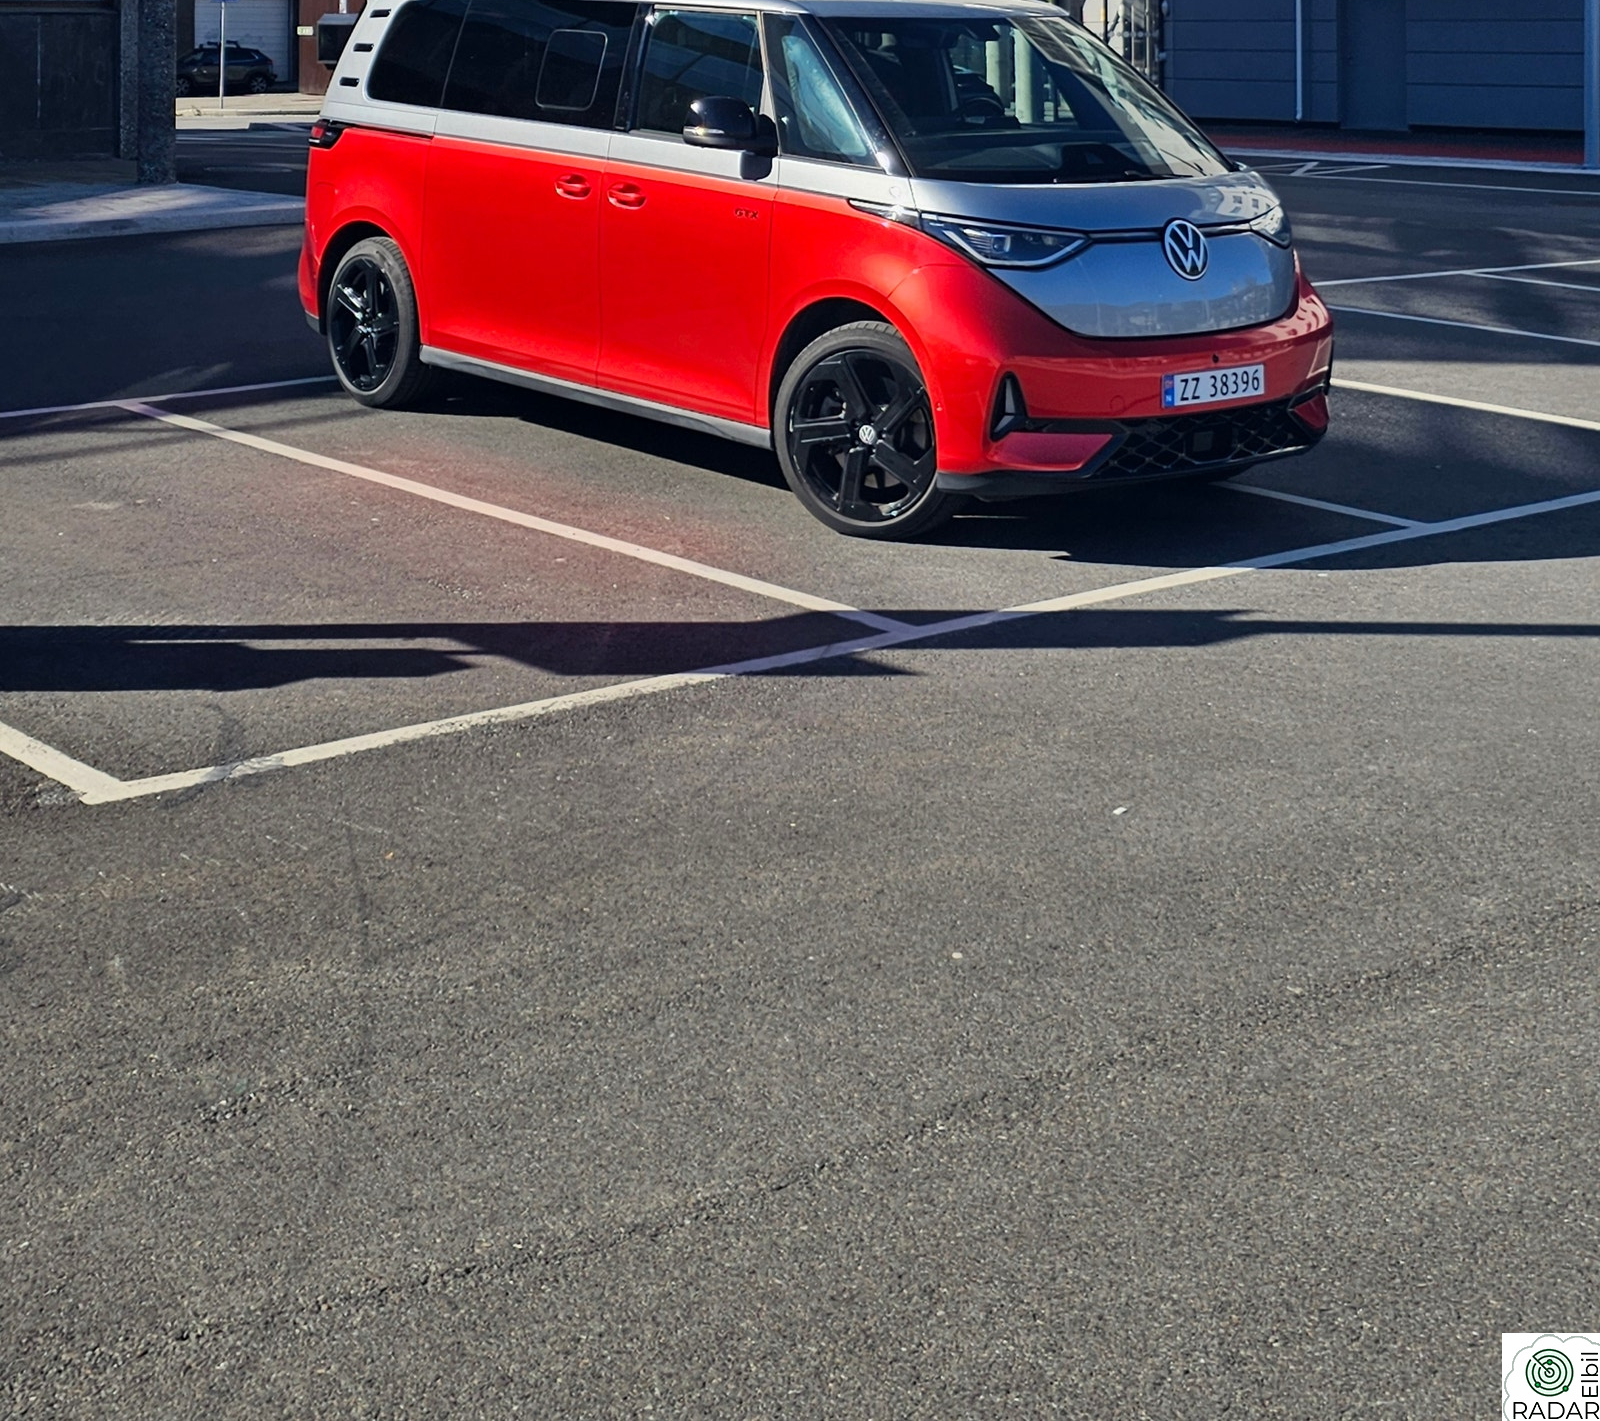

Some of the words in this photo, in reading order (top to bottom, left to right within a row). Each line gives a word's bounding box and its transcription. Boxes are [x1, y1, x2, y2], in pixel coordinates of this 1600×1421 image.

[735, 208, 758, 219] GTX
[1164, 220, 1208, 280] VW
[1180, 377, 1200, 401] ZZ
[1209, 369, 1260, 397] 38396
[859, 424, 875, 445] VW
